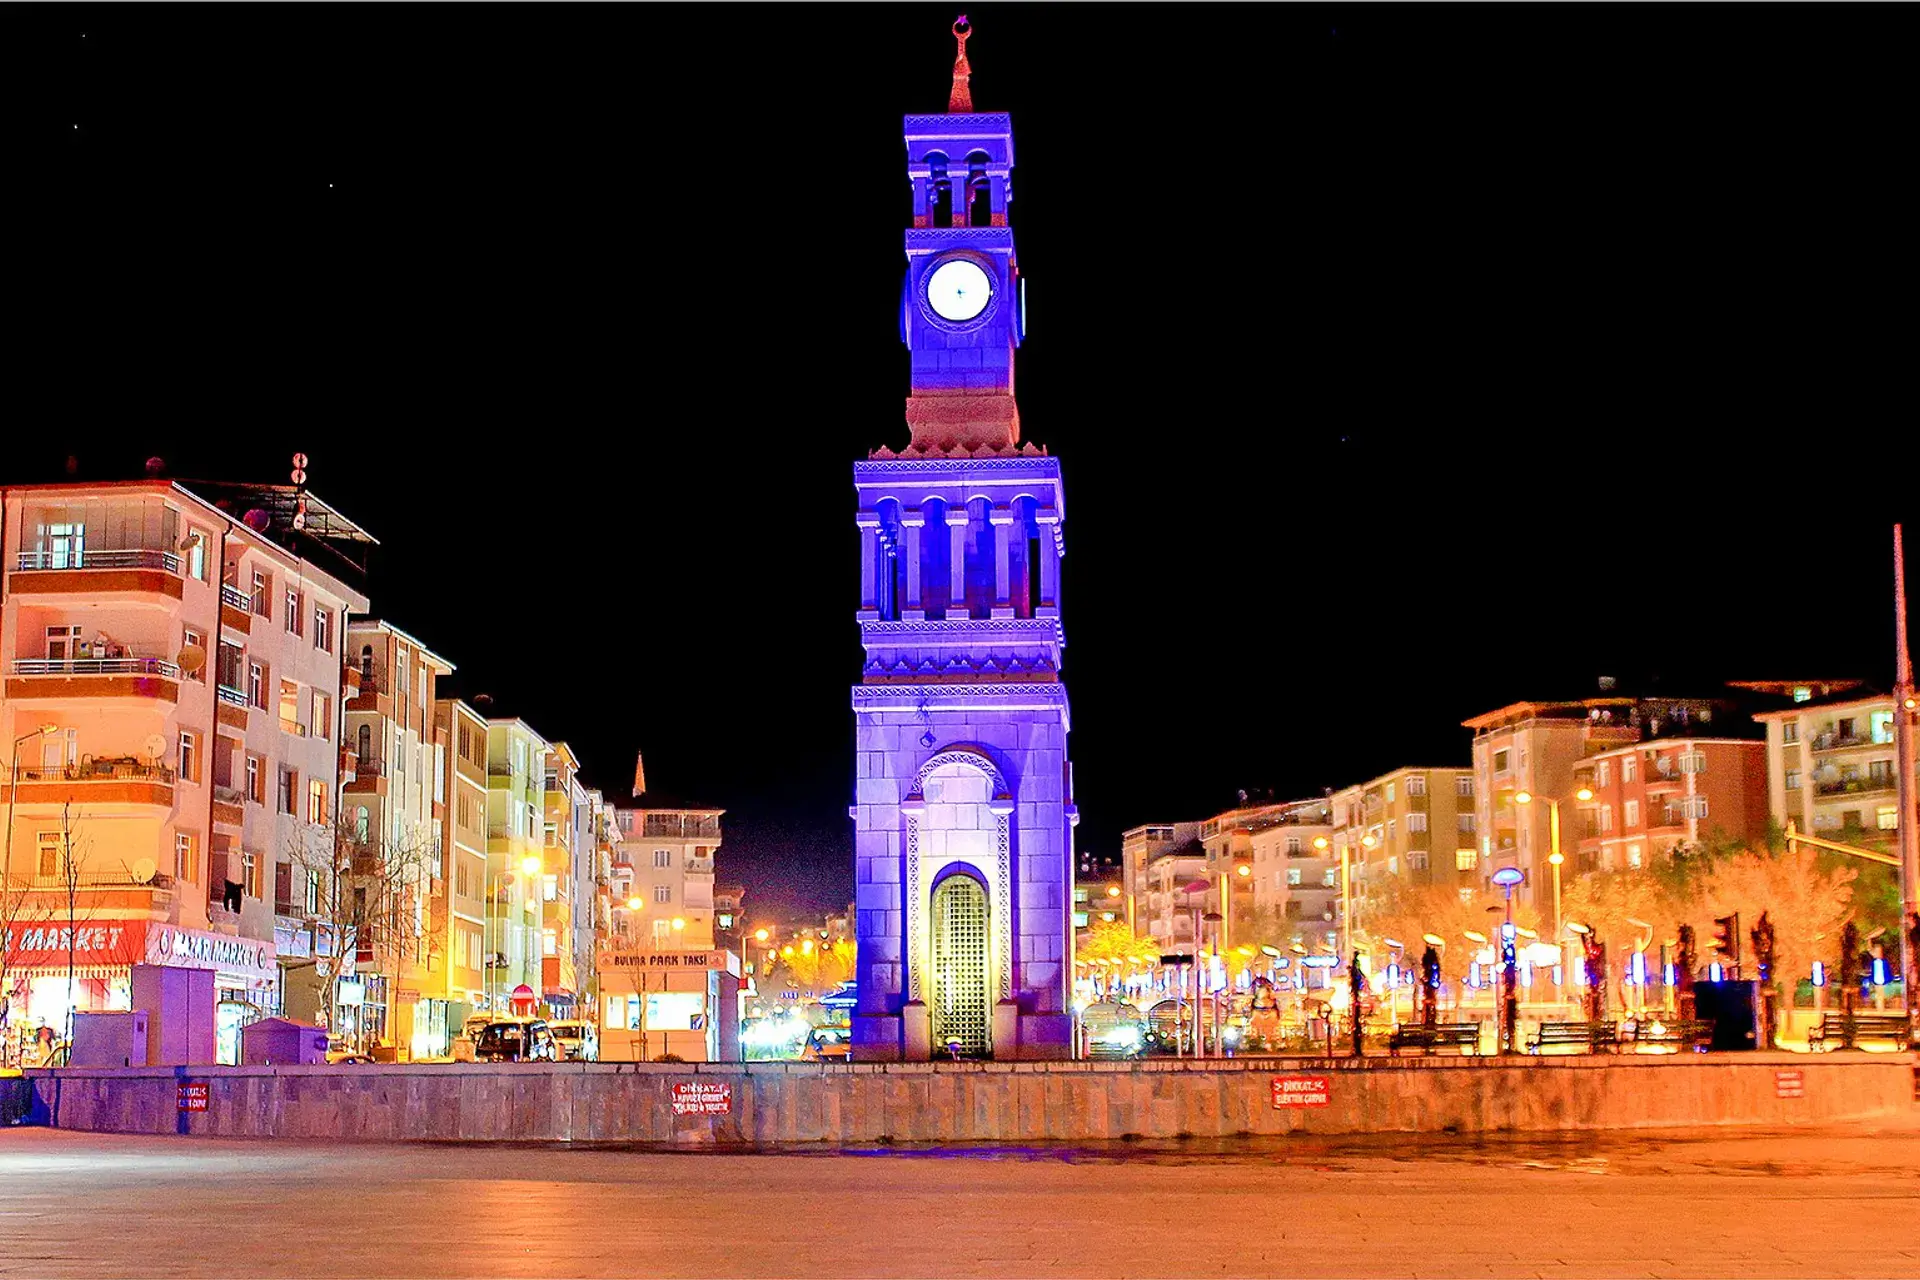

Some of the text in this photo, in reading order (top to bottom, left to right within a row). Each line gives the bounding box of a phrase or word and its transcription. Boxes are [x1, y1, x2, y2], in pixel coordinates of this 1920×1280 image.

[20, 927, 123, 952] MARKET
[211, 940, 257, 966] MARKET
[614, 955, 646, 966] BULVAR
[649, 955, 679, 966] PARK
